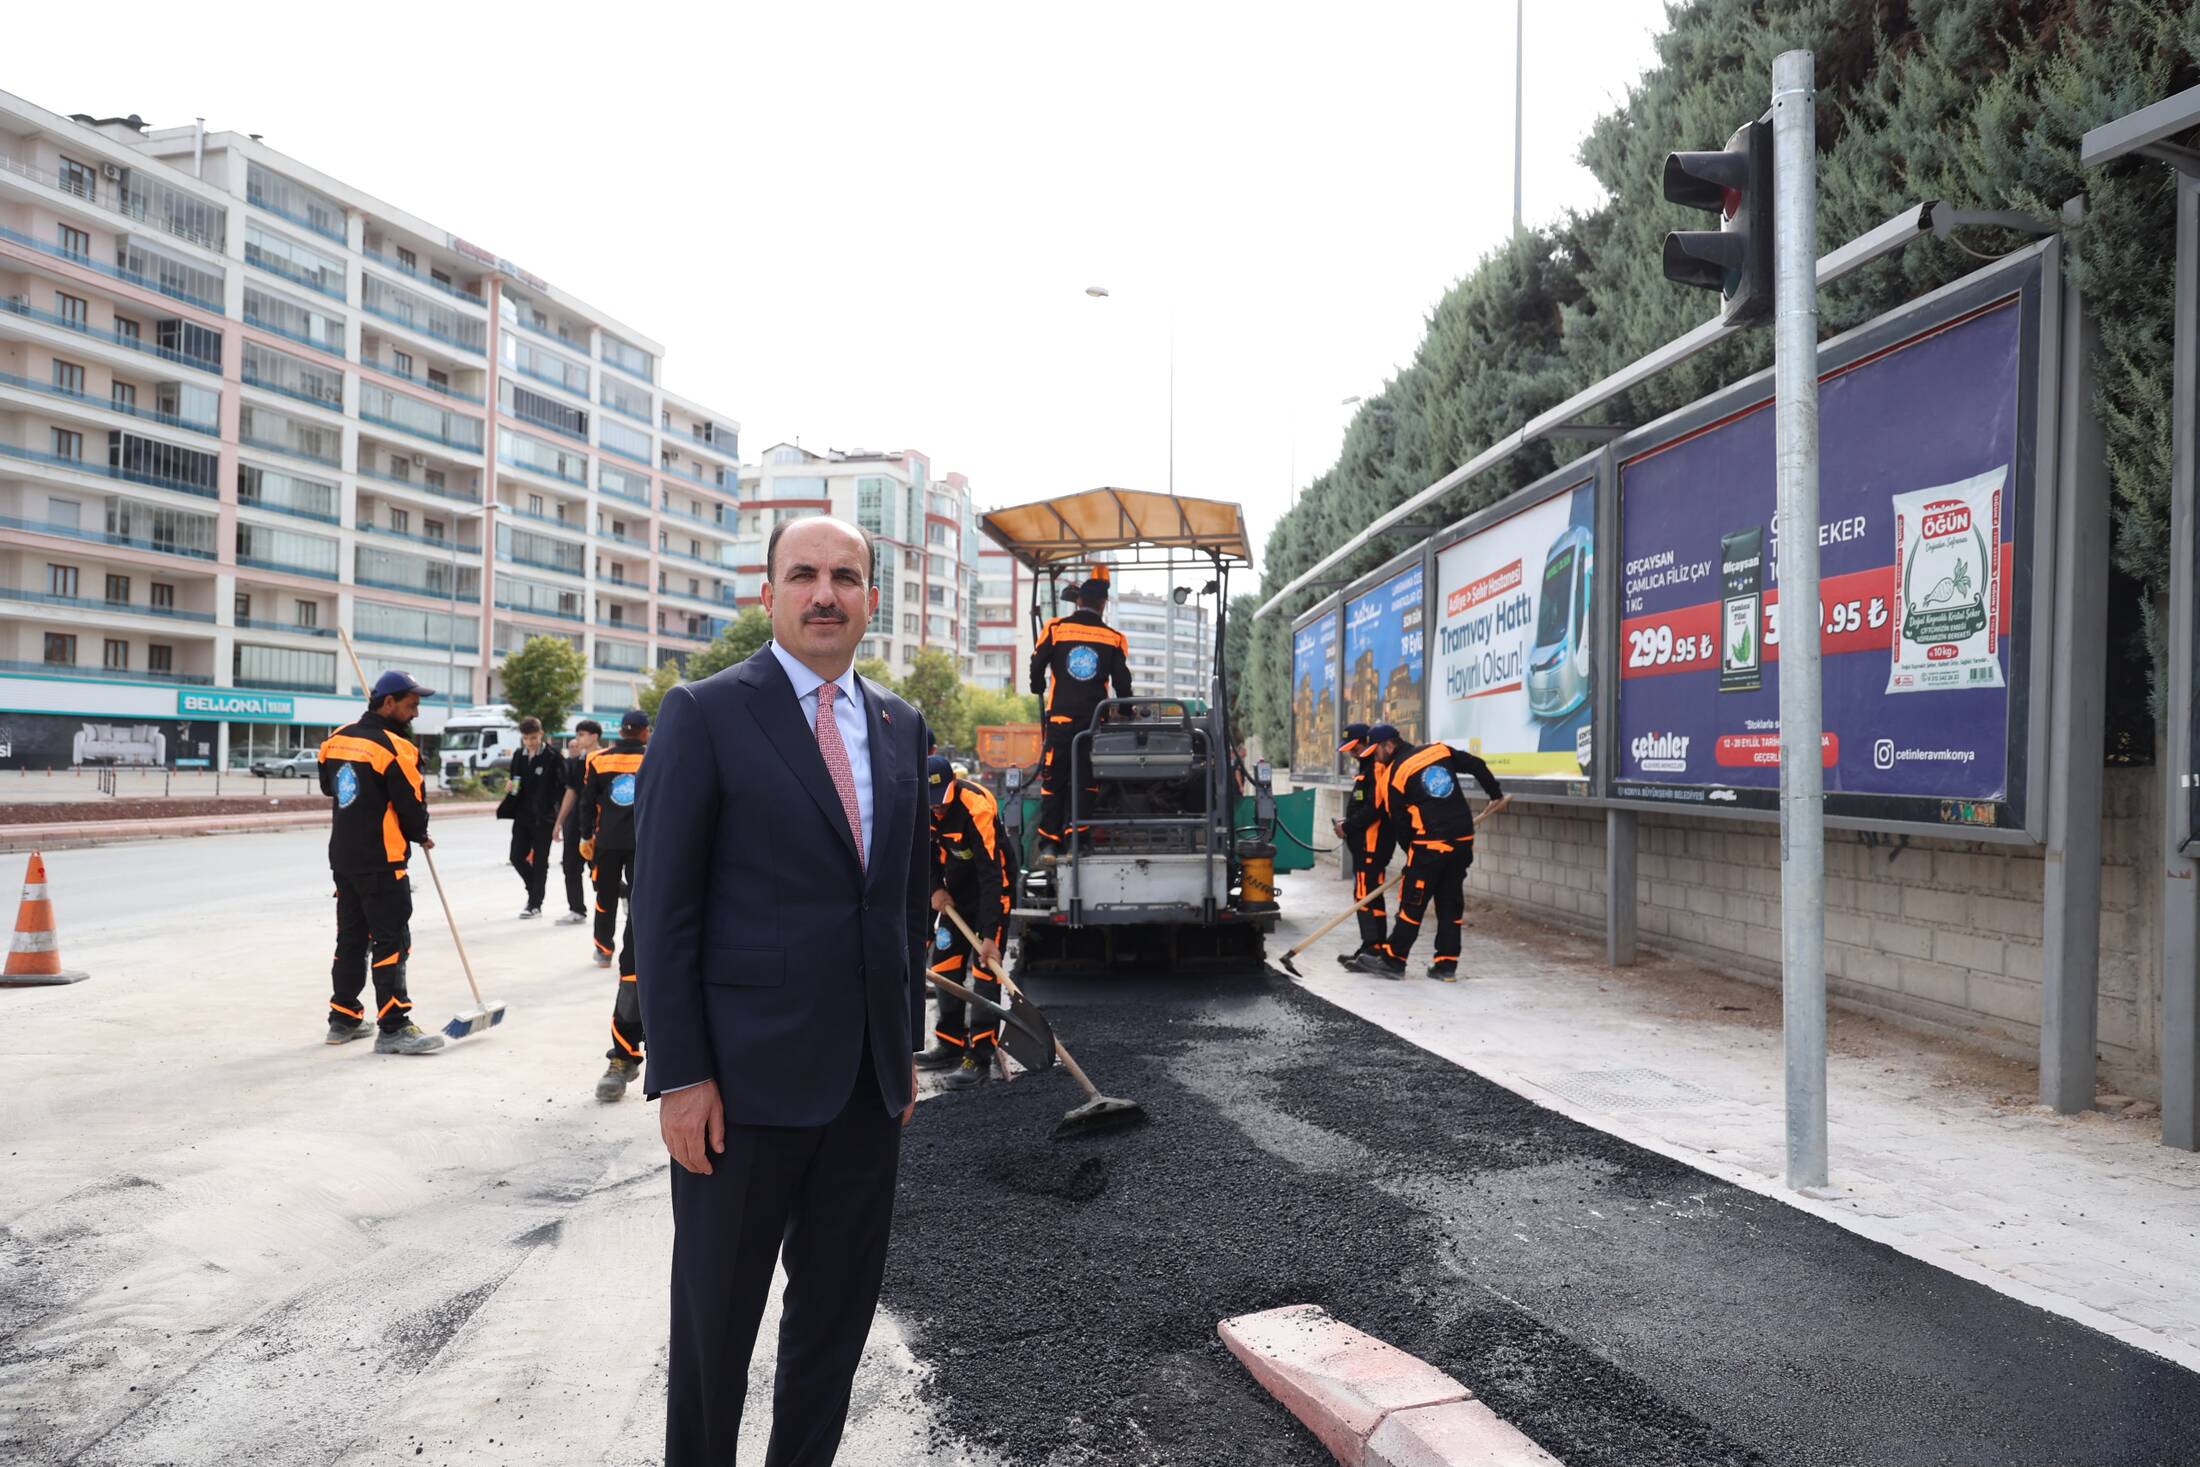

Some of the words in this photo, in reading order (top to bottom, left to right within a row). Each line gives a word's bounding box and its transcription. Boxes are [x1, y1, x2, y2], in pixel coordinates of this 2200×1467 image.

[1819, 516, 1866, 547] EKER
[1924, 512, 1968, 537] ÖĞÜN
[1626, 550, 1674, 578] OFÇAYSAN
[1626, 573, 1668, 598] ÇAMLICA
[1667, 564, 1689, 586] FİLİZ
[1690, 560, 1712, 583] ÇAY
[1631, 597, 1643, 612] KG
[1440, 613, 1493, 655] Tramvay
[1496, 592, 1531, 635] Hattı
[1628, 625, 1697, 669] 299.95
[1447, 656, 1481, 698] Hayırlı
[1483, 641, 1523, 685] Olsun!
[184, 696, 261, 713] BELLONA
[1631, 731, 1690, 763] çetinler
[1754, 752, 1780, 764] GEÇERL
[1895, 748, 1975, 763] cetinleravmkonya
